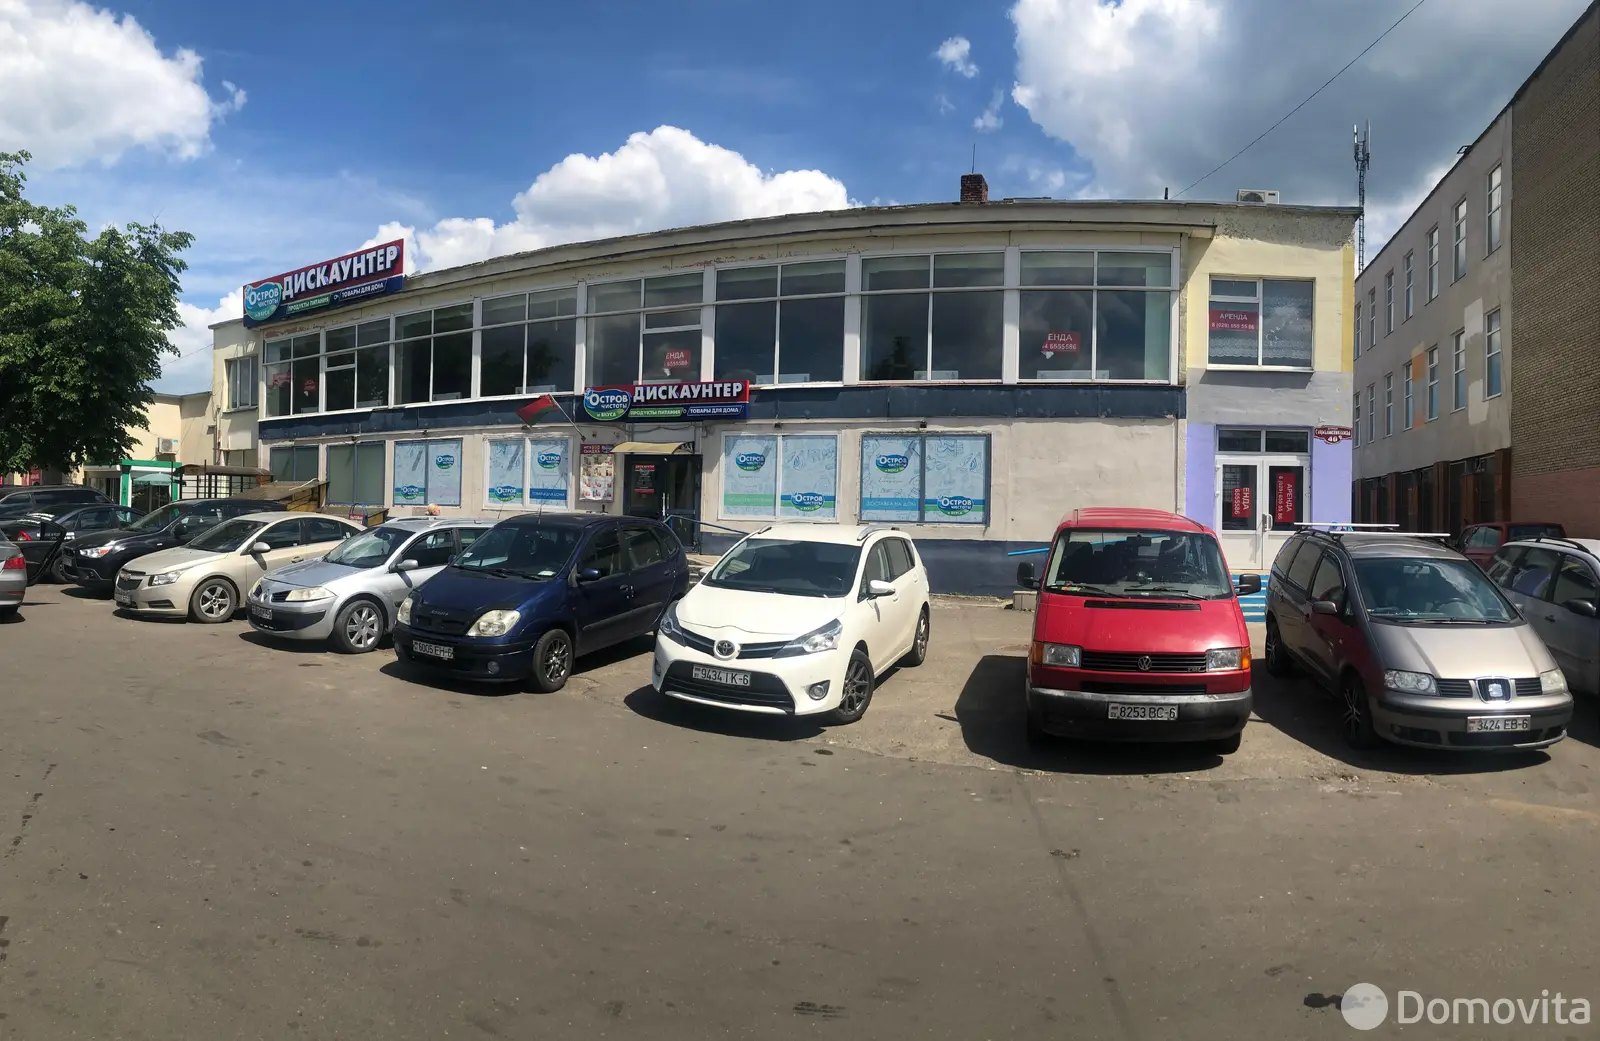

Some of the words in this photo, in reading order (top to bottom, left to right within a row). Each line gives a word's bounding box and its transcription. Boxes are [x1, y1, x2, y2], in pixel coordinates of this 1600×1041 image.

[282, 245, 398, 300] ДИСКАУНТЕР
[249, 288, 279, 305] ОСТРОВ
[341, 288, 361, 298] ТОВАРЫ
[360, 285, 371, 294] ДЛЯ
[1047, 333, 1073, 341] ЕНДА
[633, 382, 743, 403] ДИСКАУНТЕР
[589, 393, 628, 406] ОСТРОВ
[795, 493, 823, 503] ОСТРОВ
[941, 497, 972, 507] ОСТРОВ
[1242, 487, 1250, 510] ЕНДА
[701, 668, 722, 681] 9434
[1119, 706, 1146, 718] 8253
[1148, 707, 1176, 719] BC-6
[1477, 719, 1500, 731] 3424
[1503, 719, 1529, 730] EB-6
